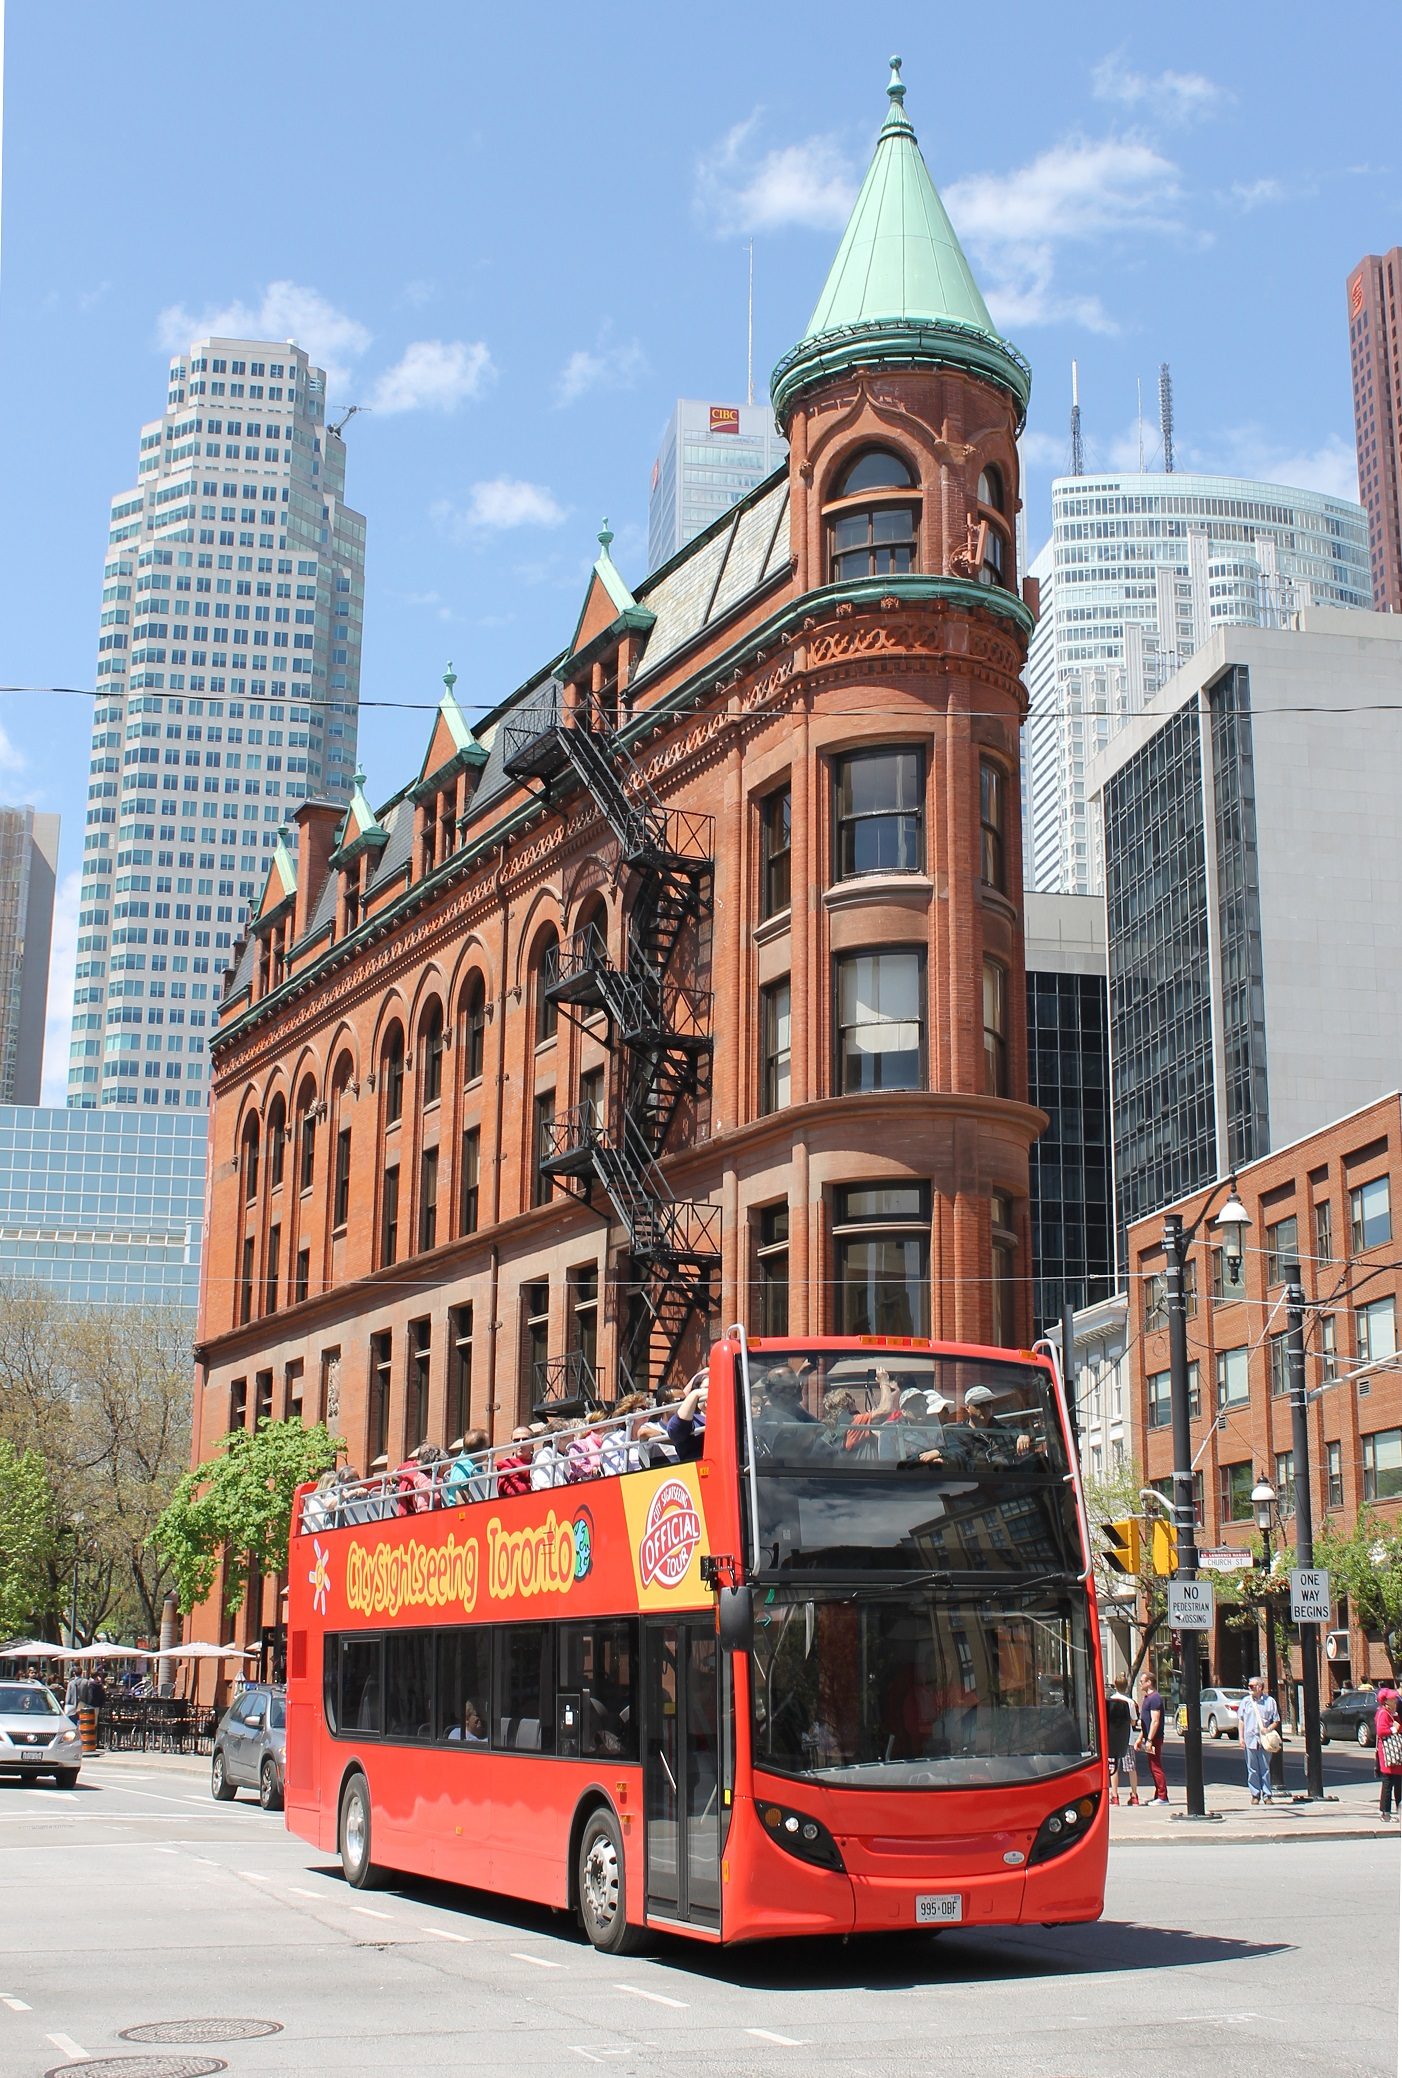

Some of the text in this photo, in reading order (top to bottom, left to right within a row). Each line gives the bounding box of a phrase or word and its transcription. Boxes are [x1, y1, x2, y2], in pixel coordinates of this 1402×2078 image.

[711, 408, 738, 420] CIBC
[653, 1485, 689, 1523] CITY SIGHTSEEING
[645, 1514, 699, 1571] OFFICIAL
[487, 1509, 576, 1600] Toronto
[666, 1547, 689, 1577] TOUR
[1207, 1558, 1244, 1566] CHURCH ST
[1300, 1573, 1320, 1586] ONE
[1183, 1586, 1199, 1600] NO
[1301, 1590, 1320, 1602] WAY
[1172, 1602, 1210, 1611] PEDESTRIAN
[1293, 1605, 1329, 1618] BEGINS
[1177, 1614, 1207, 1624] ROSSING
